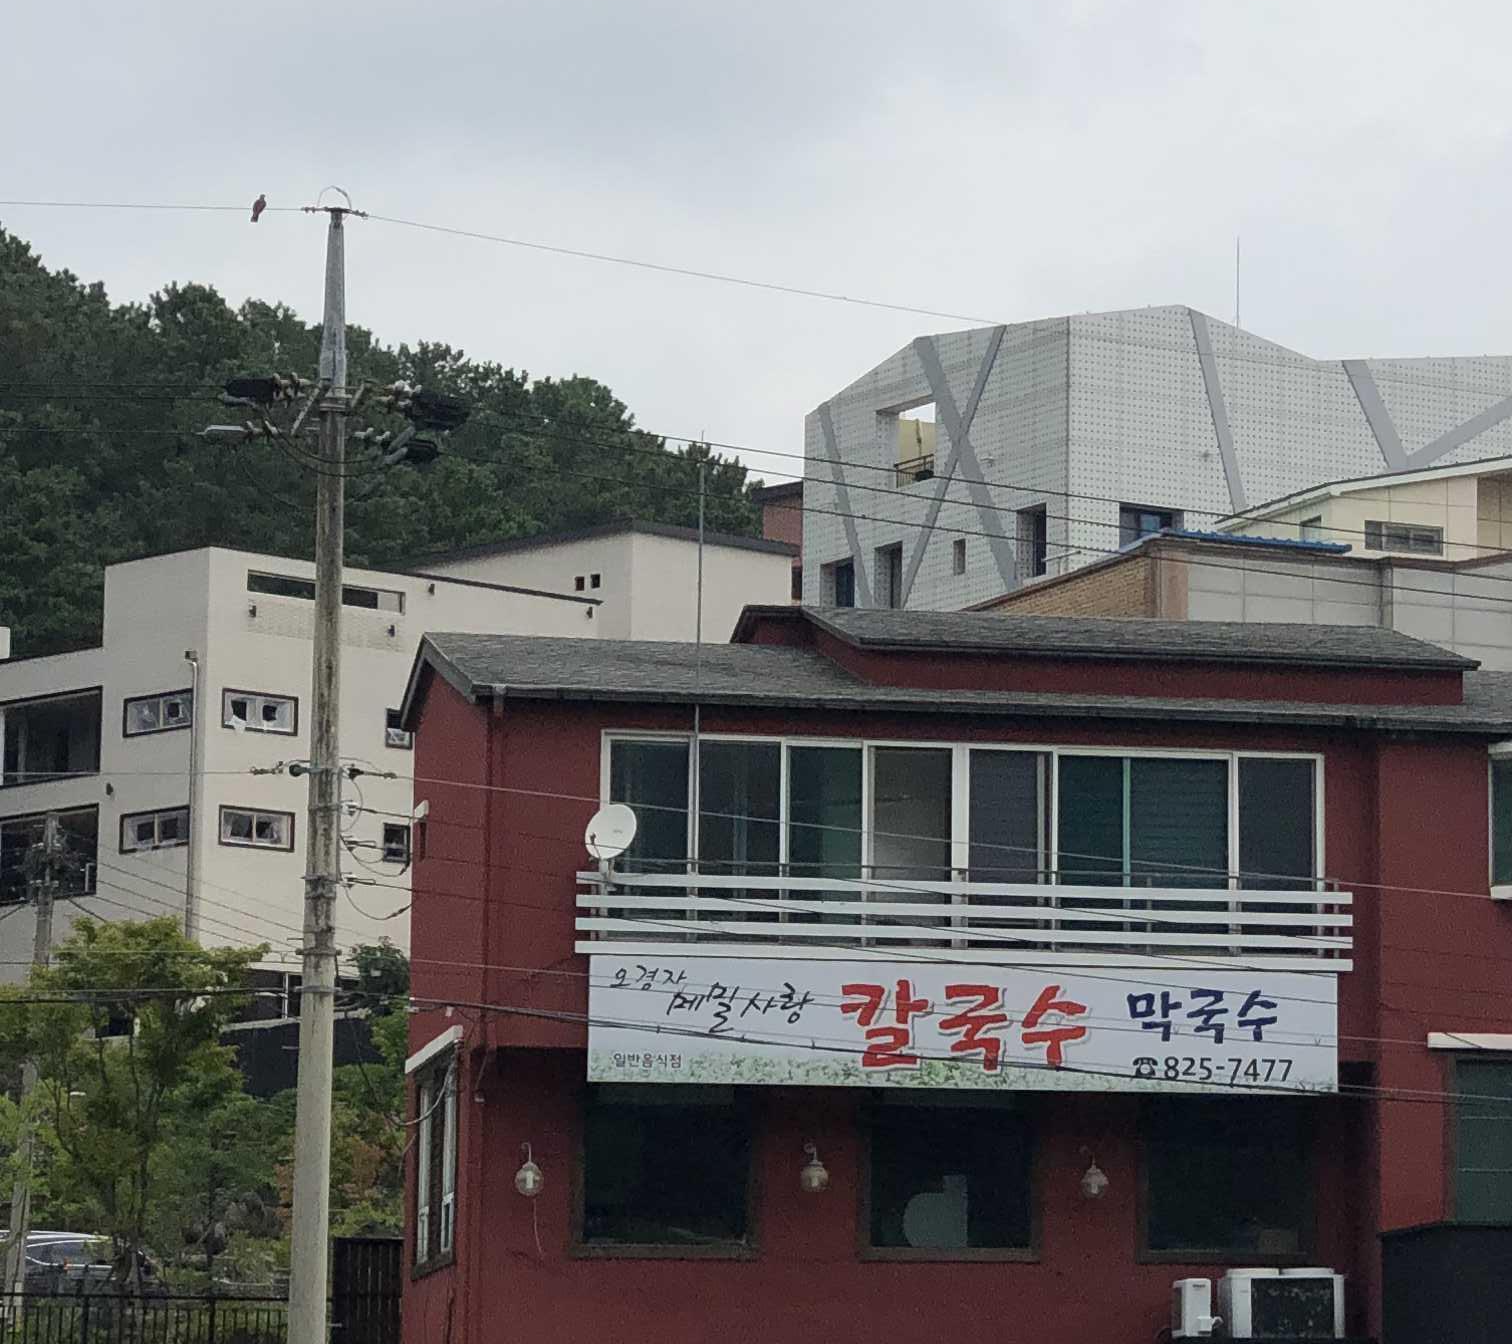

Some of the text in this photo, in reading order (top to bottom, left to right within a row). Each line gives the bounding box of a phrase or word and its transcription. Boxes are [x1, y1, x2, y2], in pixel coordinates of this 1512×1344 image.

[610, 964, 687, 991] 오경자
[840, 979, 1279, 1071] 칼국수 막국수
[613, 1053, 682, 1069] 일반음식점
[1164, 1057, 1294, 1083] 825-7477
